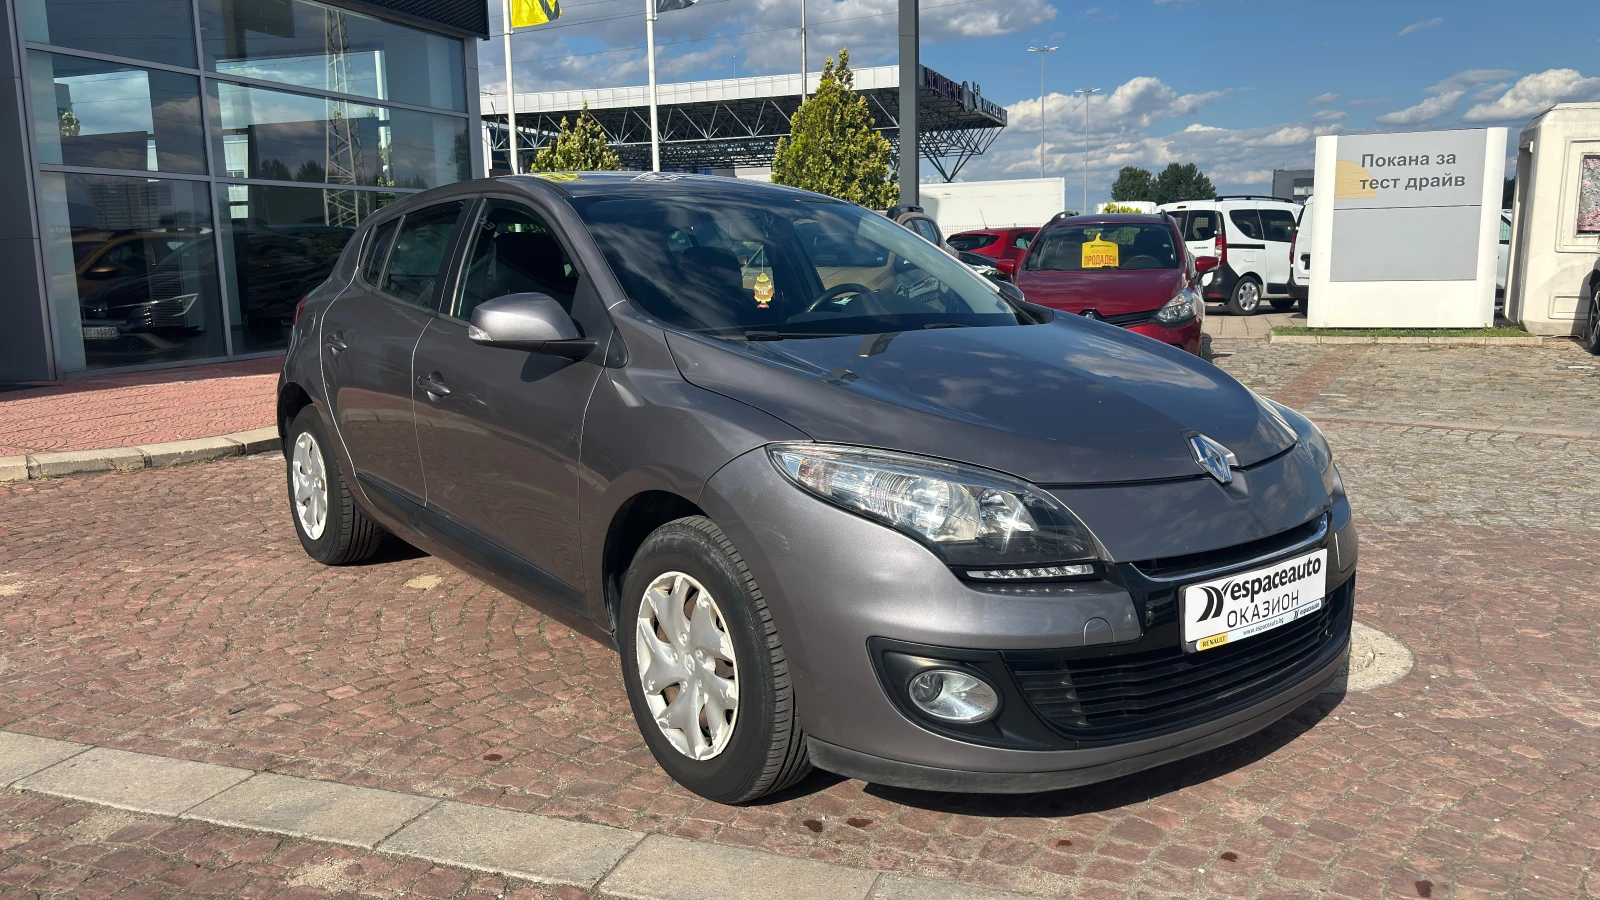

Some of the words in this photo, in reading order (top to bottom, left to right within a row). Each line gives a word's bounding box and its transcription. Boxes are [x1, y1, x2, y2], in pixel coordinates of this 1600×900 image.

[1361, 153, 1430, 168] Покана
[1436, 153, 1457, 165] за
[1359, 178, 1401, 190] тест
[1404, 172, 1466, 191] драйв
[1084, 254, 1117, 266] ПРОДАДЕН
[1230, 556, 1321, 603] espaceauto
[1227, 590, 1300, 628] ОКАЗИОН
[1202, 635, 1226, 648] RENAULT
